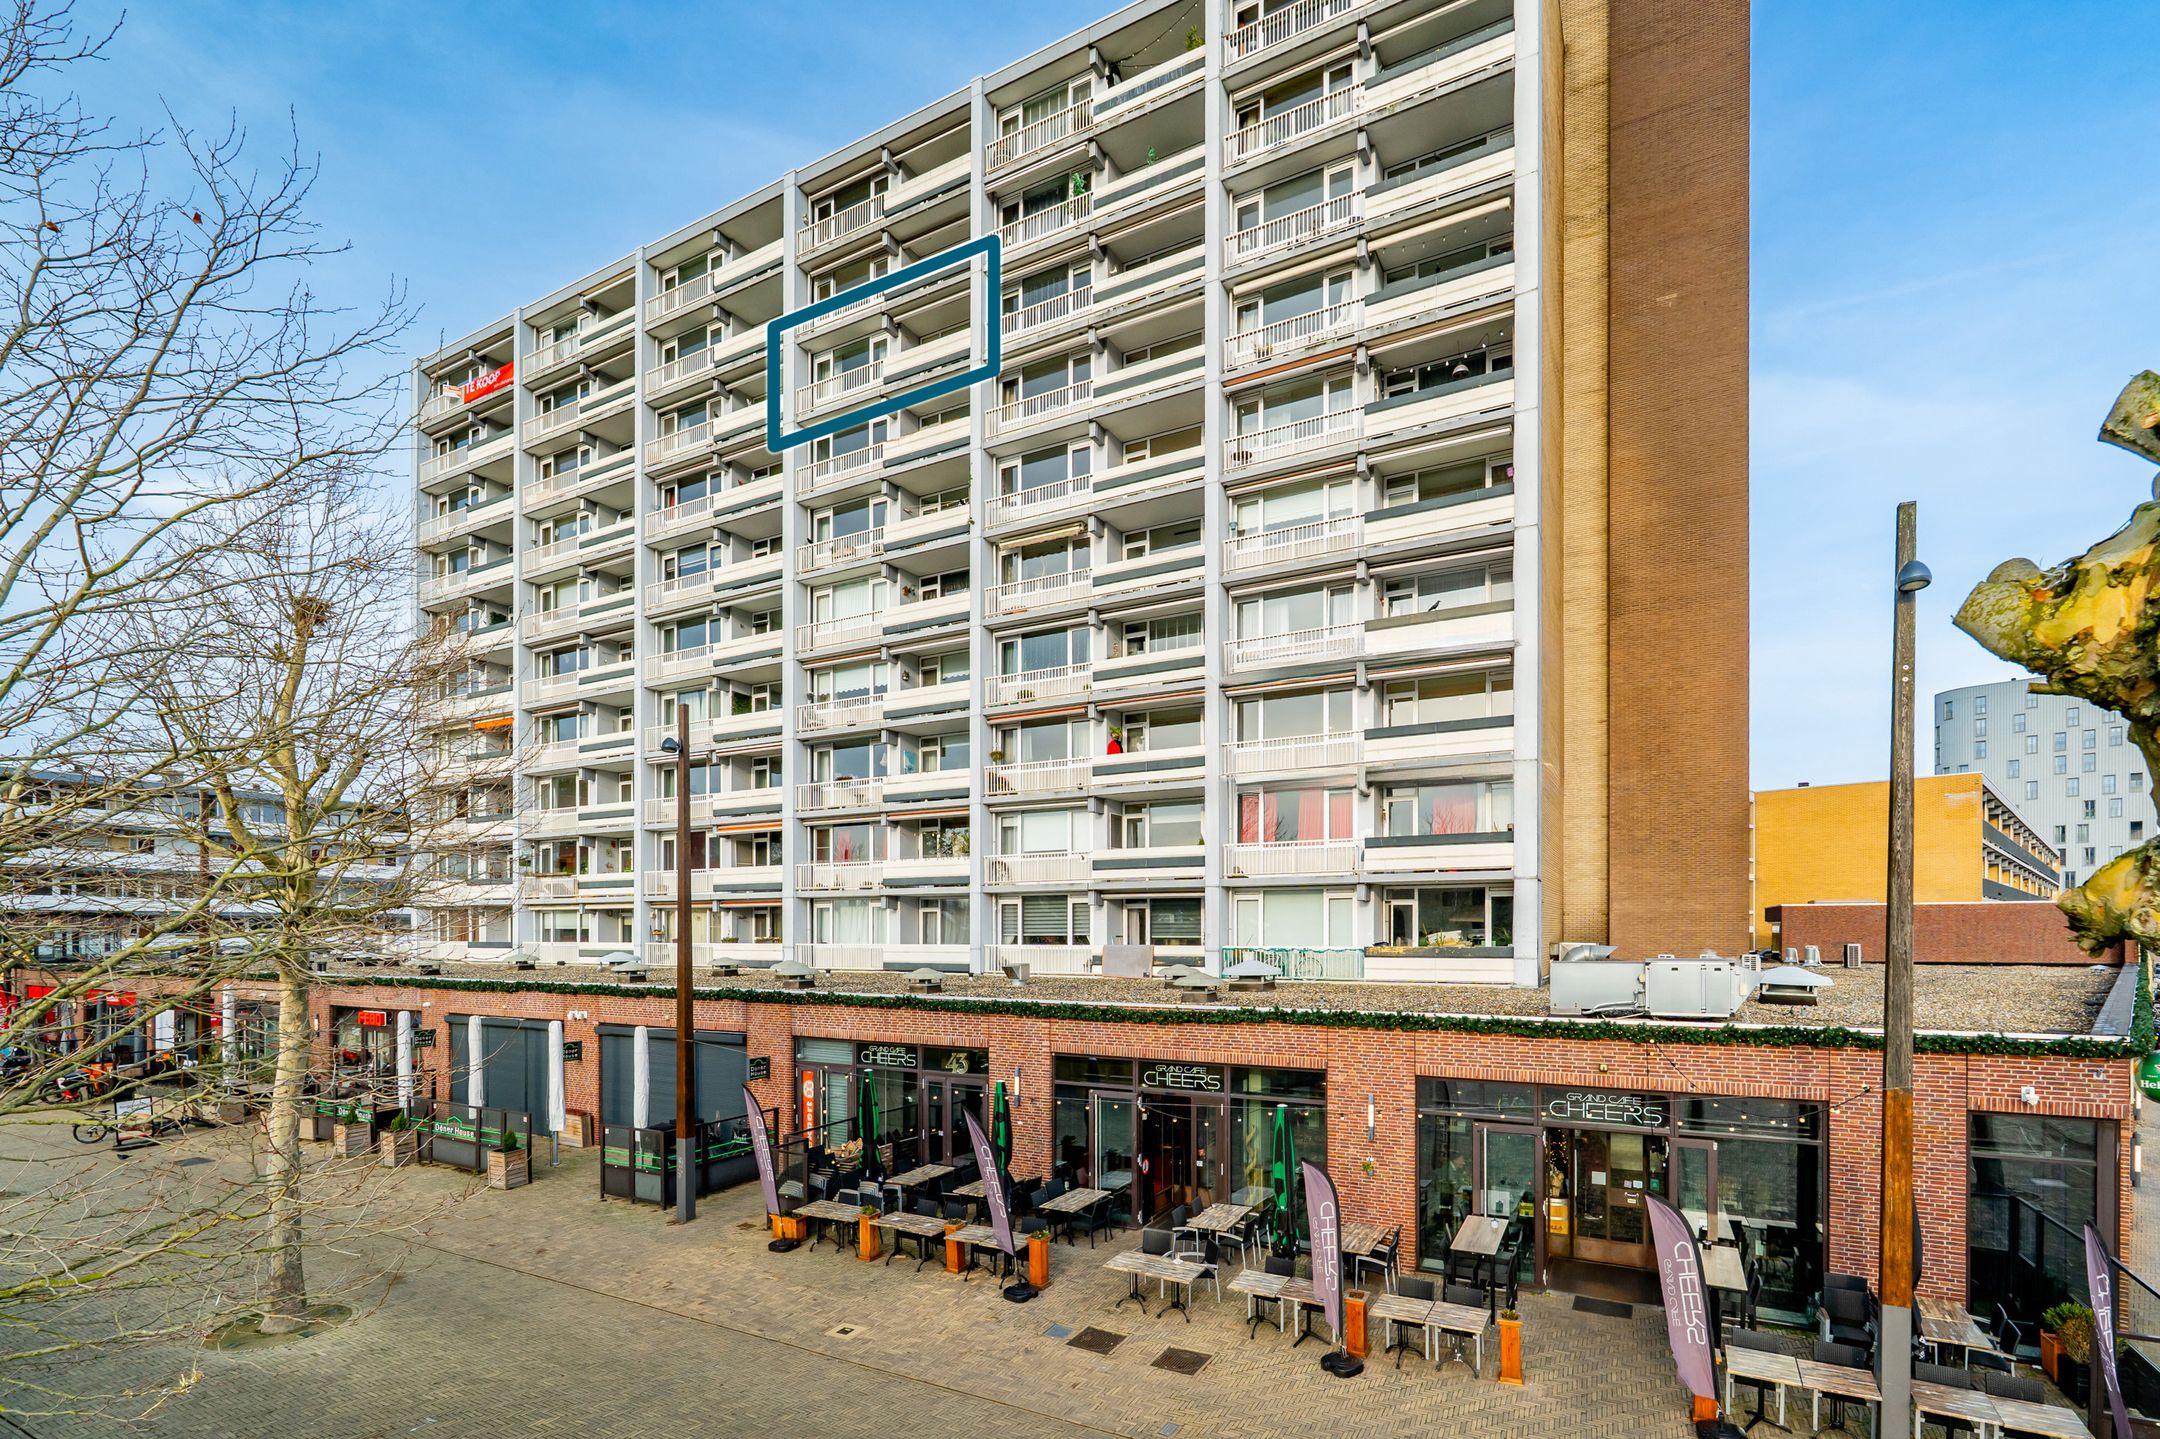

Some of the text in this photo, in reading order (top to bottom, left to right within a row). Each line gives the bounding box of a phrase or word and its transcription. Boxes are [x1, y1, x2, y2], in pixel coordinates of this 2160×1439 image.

[466, 383, 475, 394] TE
[475, 370, 501, 390] KOOP
[869, 1045, 906, 1055] GRAND CAFE
[861, 1051, 917, 1067] CHEERS
[945, 1053, 969, 1075] 43
[1155, 1064, 1207, 1075] GRAND CAFE
[1143, 1071, 1221, 1090] CHEERS
[1566, 1092, 1642, 1106] GRAND CAFE
[1549, 1100, 1663, 1124] CHEERS
[454, 1127, 475, 1138] House
